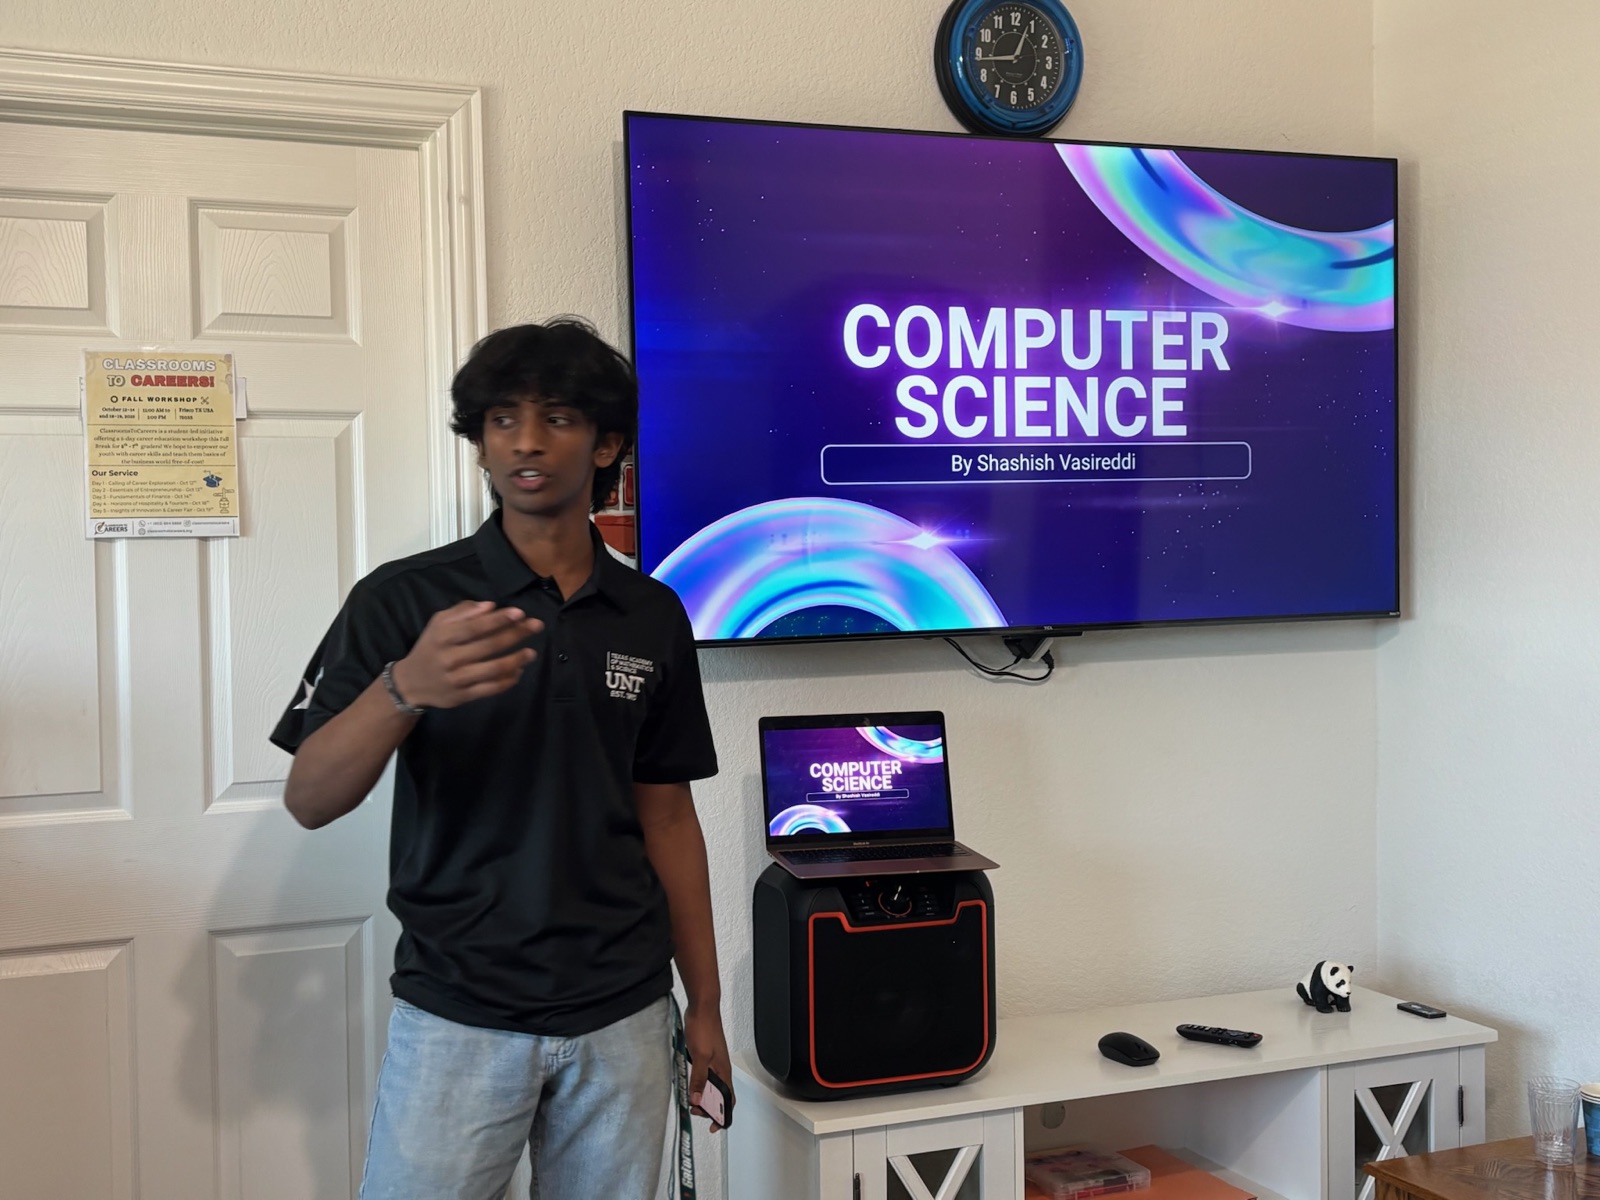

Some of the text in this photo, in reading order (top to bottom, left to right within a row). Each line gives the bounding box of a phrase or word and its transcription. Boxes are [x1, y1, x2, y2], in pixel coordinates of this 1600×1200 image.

[994, 15, 1003, 29] 11
[1010, 12, 1021, 26] 12
[1030, 20, 1035, 33] 1
[980, 28, 991, 43] 10
[1041, 35, 1048, 48] 2
[975, 47, 982, 61] 9
[1046, 56, 1052, 70] 3
[980, 68, 987, 83] 8
[1040, 76, 1048, 89] 4
[994, 84, 1000, 98] 7
[1010, 91, 1017, 105] 6
[1027, 88, 1034, 101] 5
[843, 303, 1231, 371] COMPUTER
[102, 358, 216, 372] CLASSROOMS
[107, 374, 215, 388] TO CAREERS!
[895, 375, 1187, 438] SCIENCE
[951, 452, 1136, 476] By Shashish Vasireddi
[605, 671, 645, 693] UNT
[809, 760, 902, 778] COMPUTER
[822, 775, 893, 792] SCIENCE
